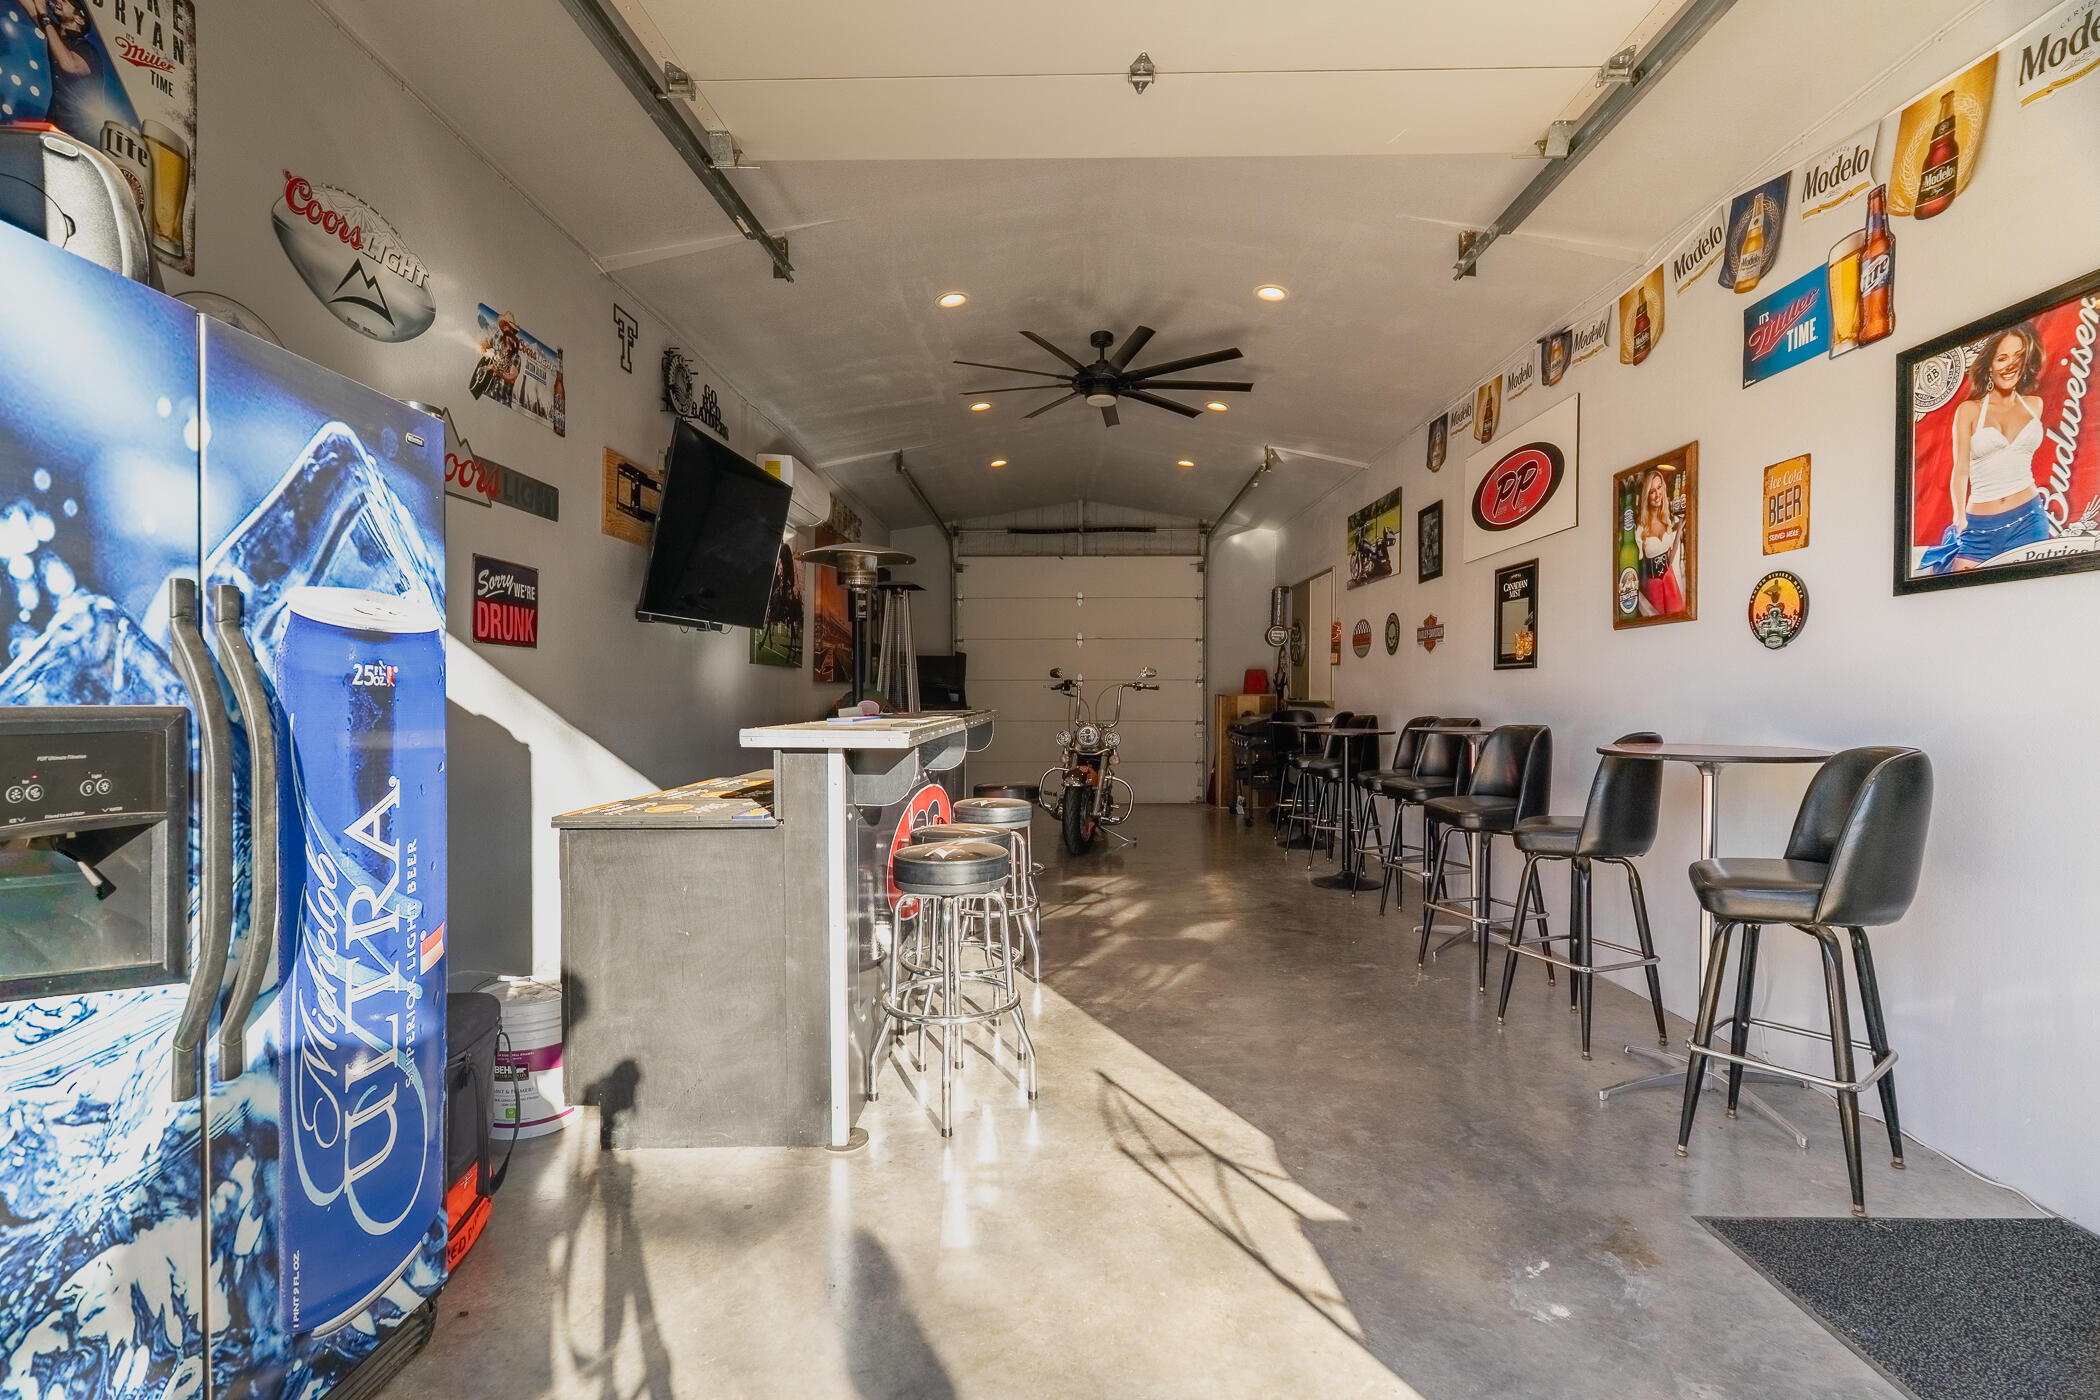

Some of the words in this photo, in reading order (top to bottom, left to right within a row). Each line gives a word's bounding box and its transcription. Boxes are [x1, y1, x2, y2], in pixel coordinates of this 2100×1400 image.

[93, 0, 184, 66] RYAN
[114, 36, 176, 74] Miller
[106, 130, 148, 168] Lite
[1802, 144, 1870, 203] Modelo
[1924, 165, 1954, 188] Modelo
[283, 169, 363, 251] Coors
[361, 235, 430, 289] LIGHT
[1673, 226, 1723, 283] Modelo
[1572, 320, 1606, 354] Modelo
[1749, 287, 1820, 361] Miller
[1759, 311, 1770, 326] IT'S
[1507, 361, 1532, 393] Modelo
[1451, 402, 1472, 428] Modelo
[2037, 296, 2100, 538] Budweiser
[444, 453, 503, 500] oors
[1492, 459, 1539, 518] PP
[1769, 475, 1781, 490] Ice
[1783, 467, 1803, 486] Cold
[1769, 484, 1802, 528] BEER
[477, 569, 514, 597] Sorry
[512, 582, 535, 600] WE'RE
[477, 600, 535, 642] DRUNK
[352, 663, 374, 686] 25
[406, 838, 417, 895] BEER
[406, 902, 416, 970] LIGHT
[300, 853, 340, 1149] Michelob
[344, 775, 400, 1194] ULTRA
[405, 976, 416, 1087] SUPERIOR
